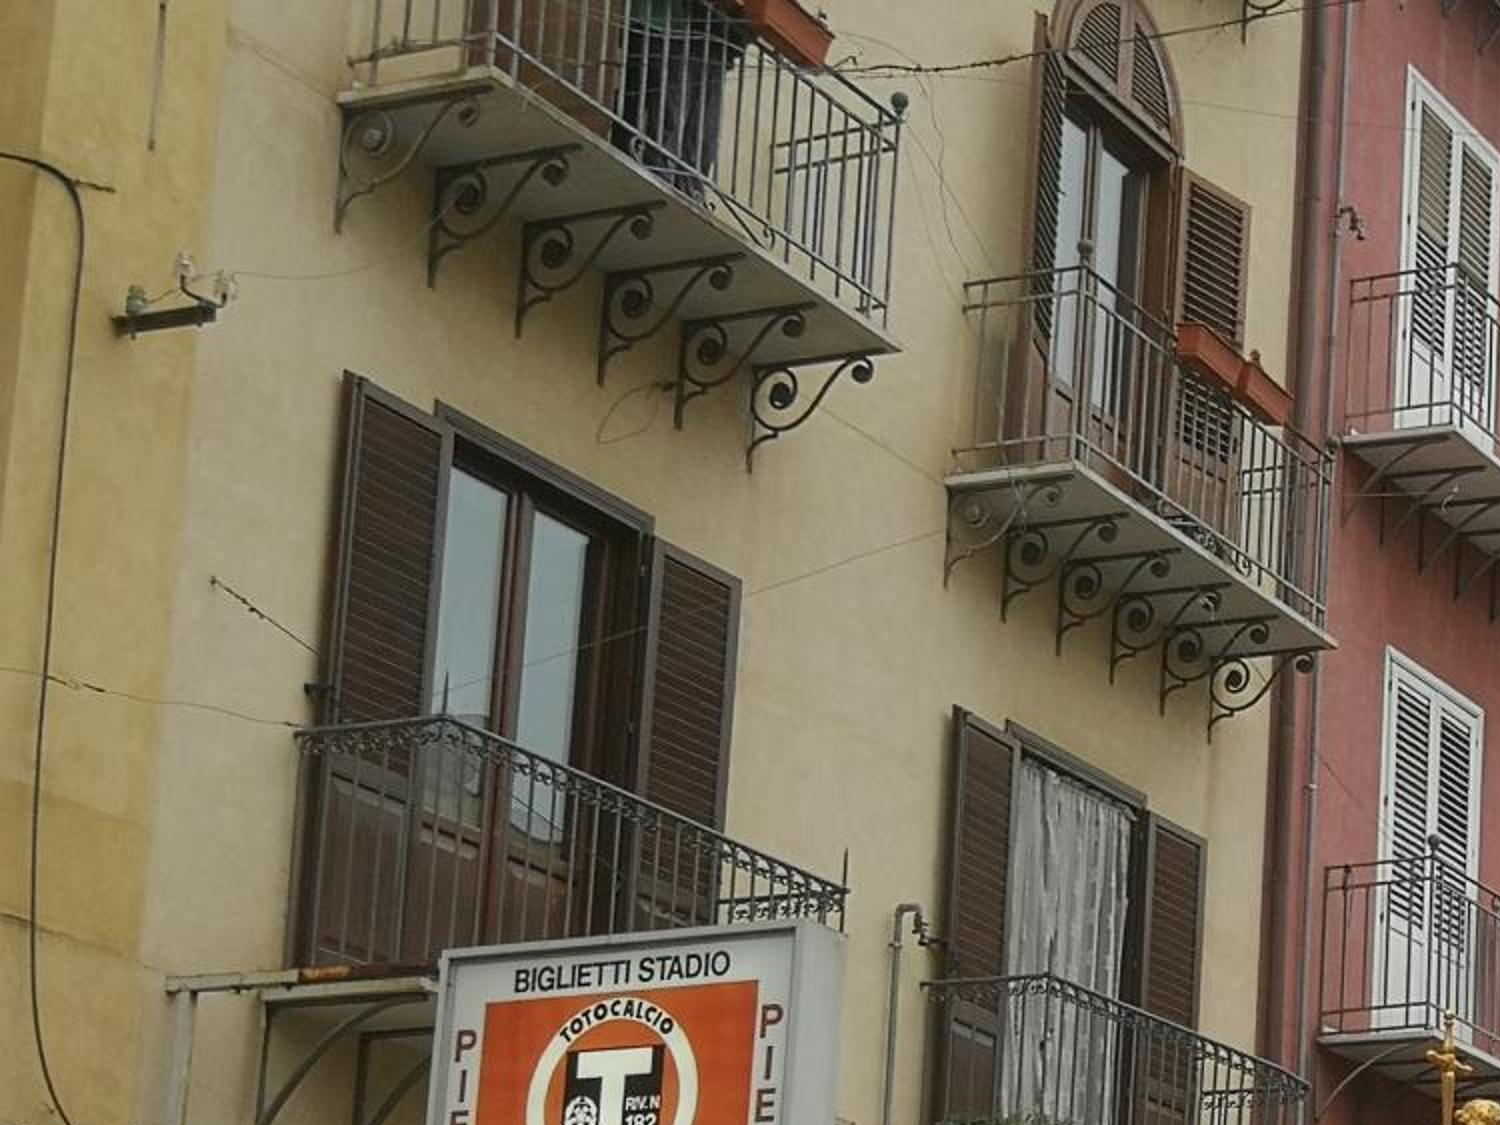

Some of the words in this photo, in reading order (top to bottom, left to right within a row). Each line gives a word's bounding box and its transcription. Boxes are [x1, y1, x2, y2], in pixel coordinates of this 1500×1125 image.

[513, 960, 631, 993] BIGLIETTI
[638, 950, 731, 983] STADIO
[559, 999, 675, 1043] TOTOCALCIO
